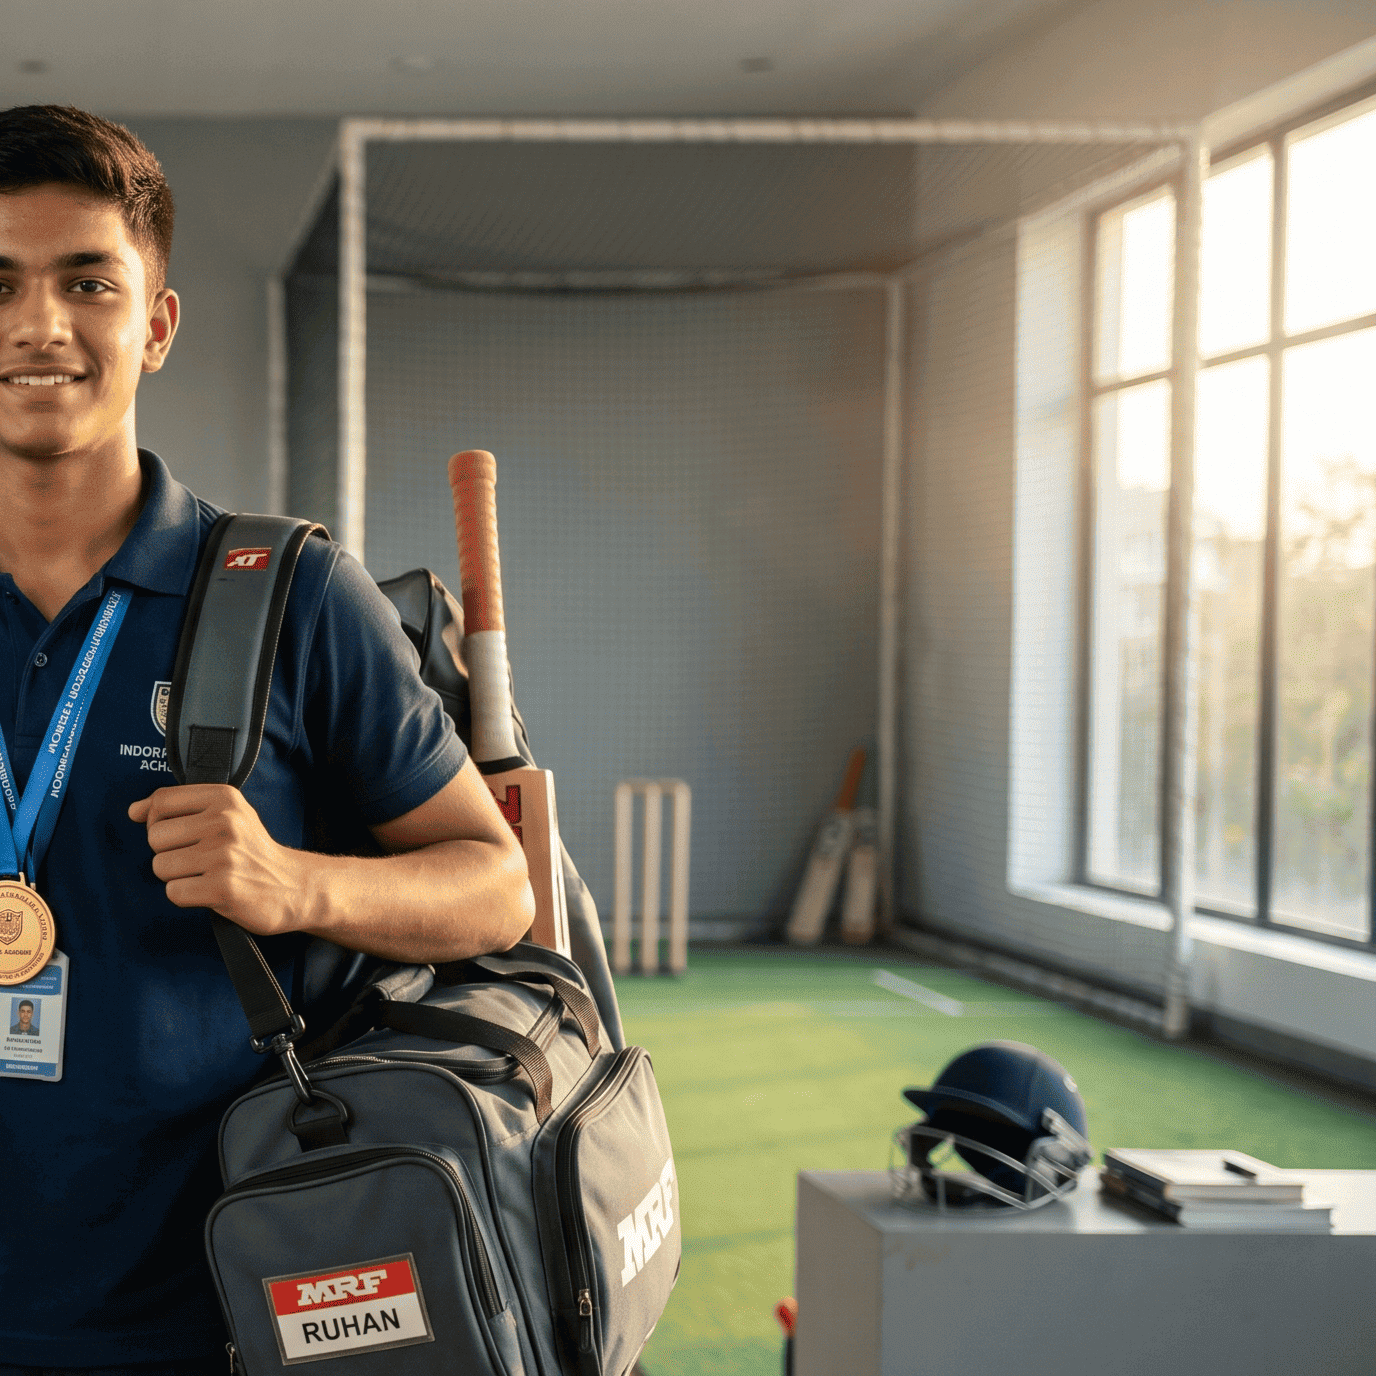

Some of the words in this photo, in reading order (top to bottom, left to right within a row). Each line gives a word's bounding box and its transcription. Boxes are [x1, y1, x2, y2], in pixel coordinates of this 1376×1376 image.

[140, 760, 173, 772] ACH
[617, 1157, 674, 1288] MRF
[296, 1269, 388, 1307] MRF
[302, 1308, 401, 1344] RUHAN
